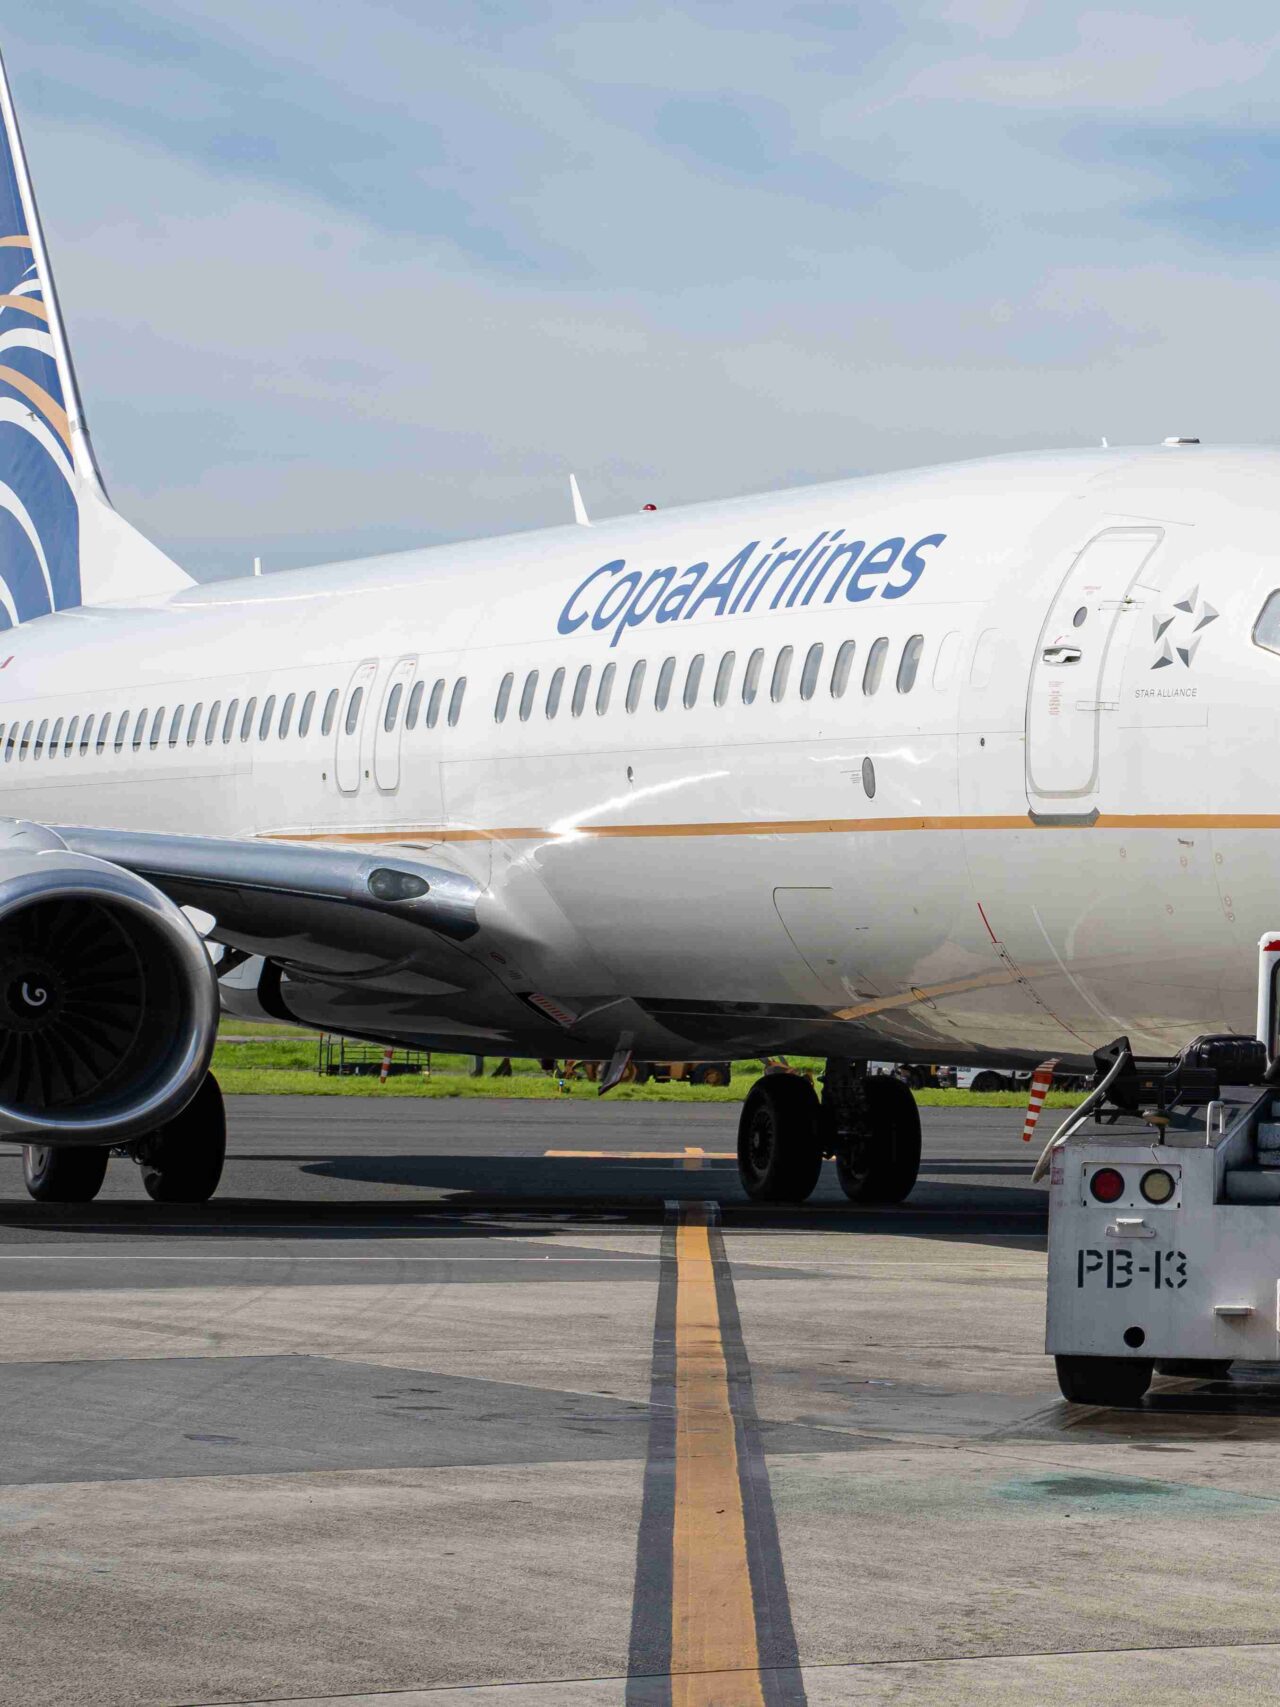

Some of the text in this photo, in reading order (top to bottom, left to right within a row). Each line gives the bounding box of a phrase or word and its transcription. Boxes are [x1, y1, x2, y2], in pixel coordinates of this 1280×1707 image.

[557, 529, 947, 647] CopaAirlines
[1135, 687, 1197, 698] STAR ALLIANCE
[1077, 1249, 1189, 1289] PB-13
